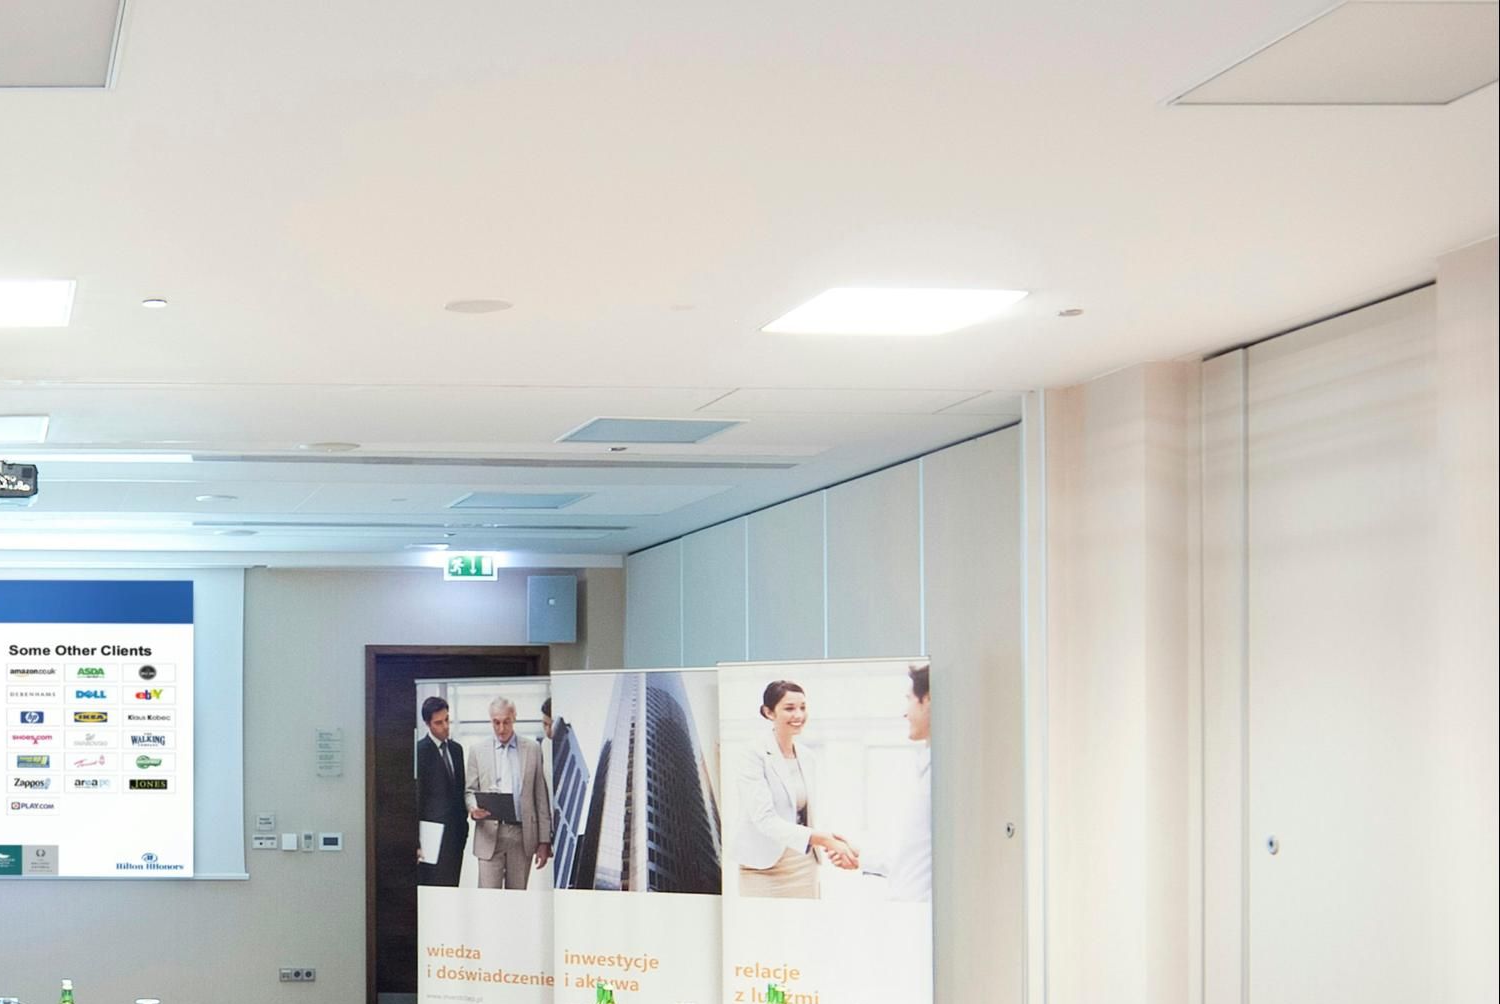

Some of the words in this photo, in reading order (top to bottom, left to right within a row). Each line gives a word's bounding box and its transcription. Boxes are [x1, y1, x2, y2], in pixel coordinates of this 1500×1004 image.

[8, 645, 51, 656] Some
[55, 645, 97, 656] Other
[100, 645, 152, 657] Clients
[77, 667, 105, 676] ASDA
[75, 690, 107, 699] DELL
[131, 735, 165, 746] WALKING
[14, 777, 45, 788] Zappos
[132, 779, 166, 789] JONES
[116, 862, 144, 870] Hilton
[426, 943, 481, 960] wiedza
[564, 949, 659, 973] inwestycje
[427, 964, 432, 978] i
[436, 965, 555, 987] doświadczenie
[735, 962, 800, 984] relacje
[564, 972, 569, 987] i
[734, 991, 744, 1002] z
